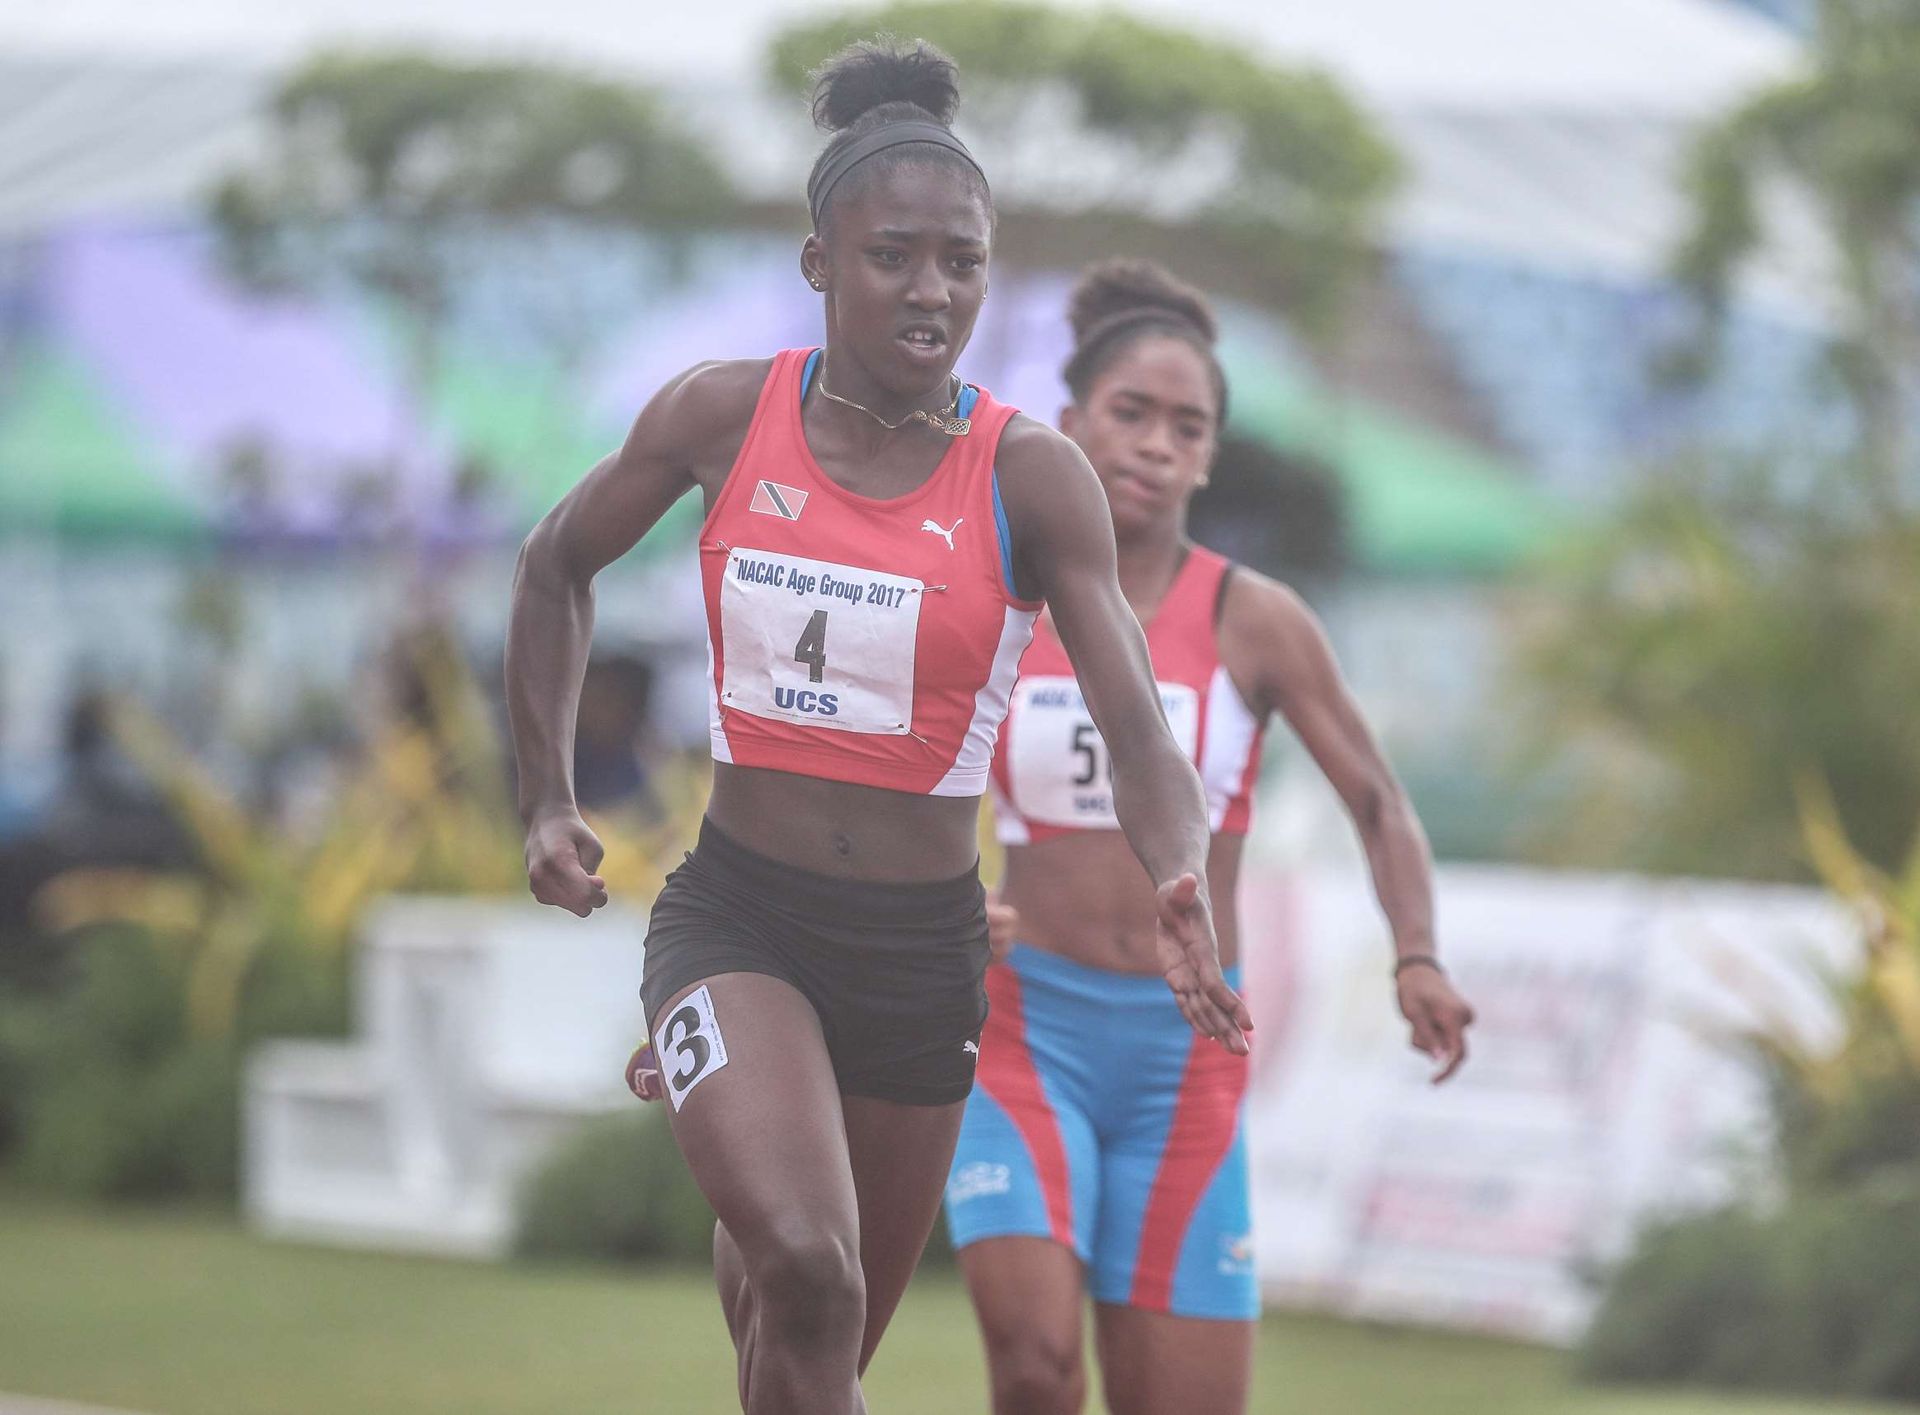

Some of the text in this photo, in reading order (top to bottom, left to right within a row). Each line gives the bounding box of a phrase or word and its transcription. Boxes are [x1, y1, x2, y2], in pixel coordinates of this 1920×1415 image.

[737, 559, 905, 608] NACAC Age Group 2017
[795, 609, 828, 683] 4
[775, 686, 839, 716] UCS
[1072, 725, 1112, 785] 5
[664, 1006, 711, 1092] 3
